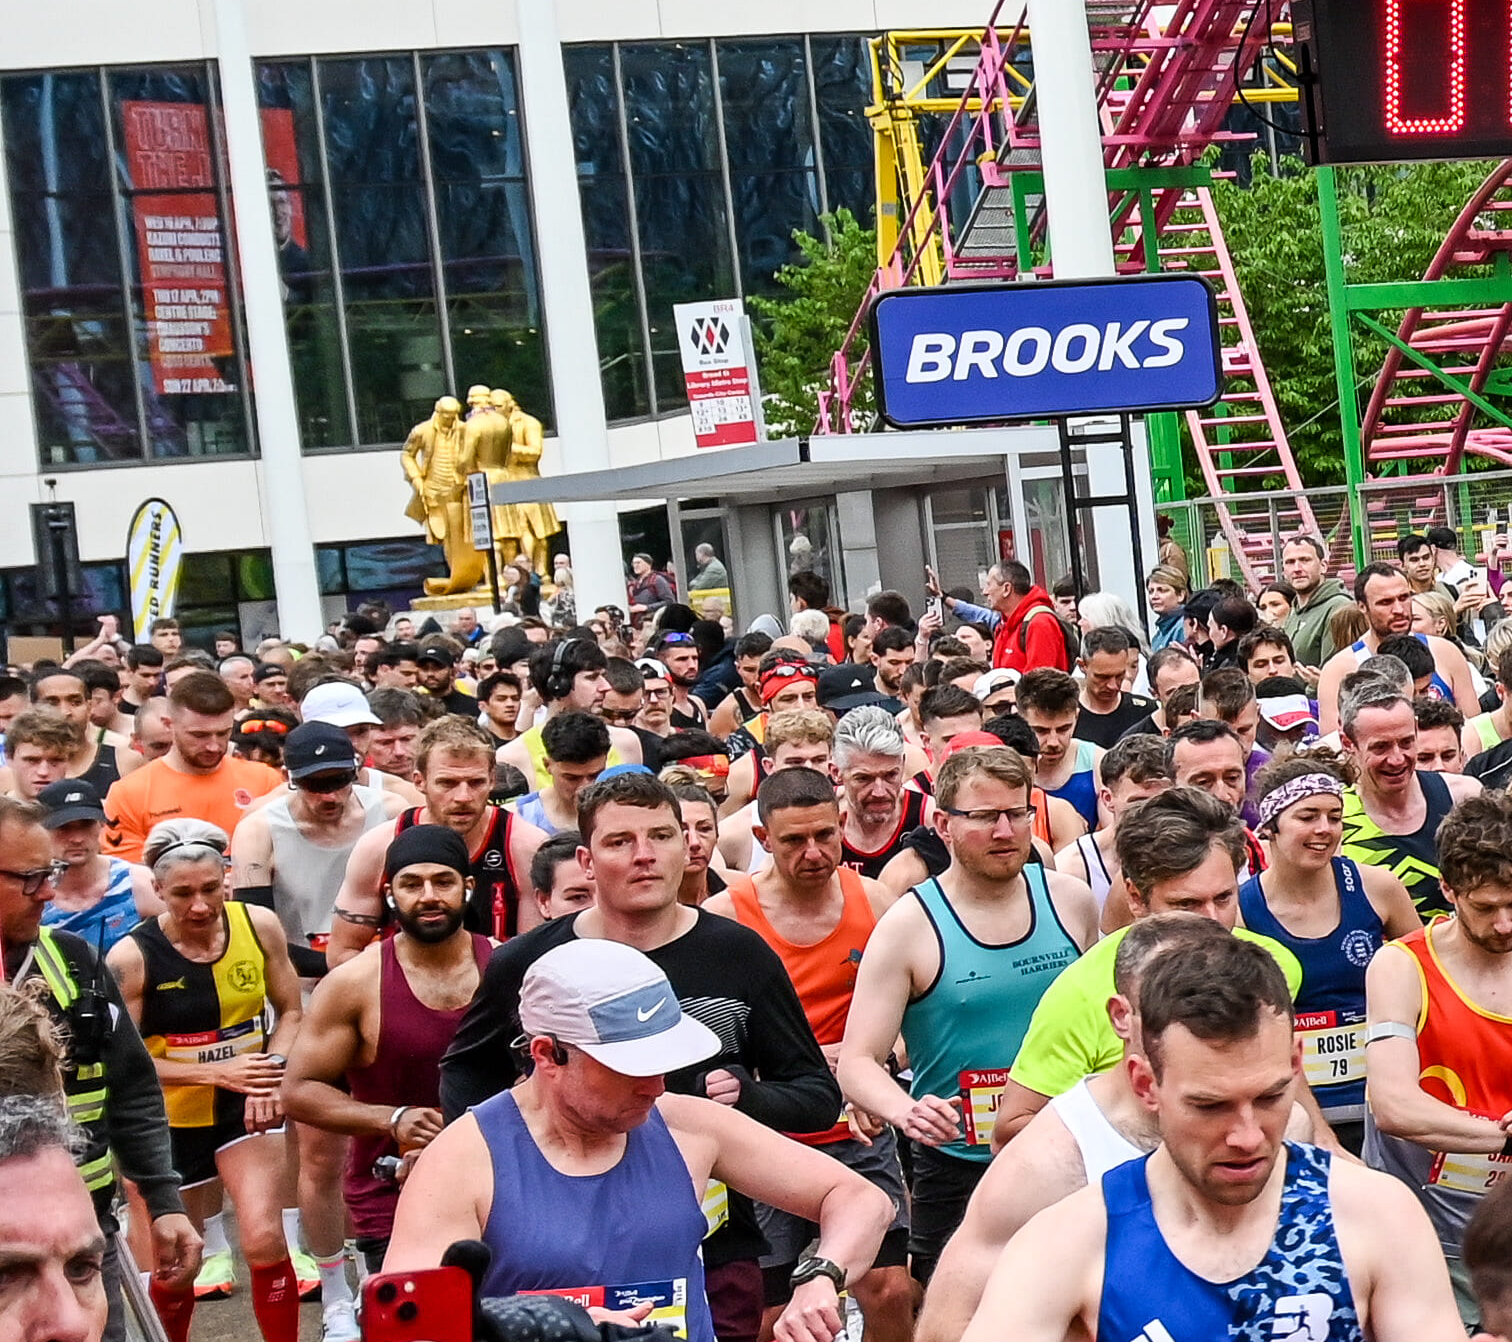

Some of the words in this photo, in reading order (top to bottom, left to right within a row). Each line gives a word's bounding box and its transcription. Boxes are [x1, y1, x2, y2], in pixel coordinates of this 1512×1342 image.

[905, 318, 1189, 384] BROOKS
[149, 511, 162, 590] RUNNERS
[1012, 949, 1069, 969] BOURNVILLE
[1020, 958, 1068, 977] HARRIERS
[1297, 1016, 1327, 1028] AJBell
[198, 1044, 237, 1064] HAZEL
[1316, 1032, 1356, 1056] ROSIE
[1329, 1057, 1348, 1078] 79
